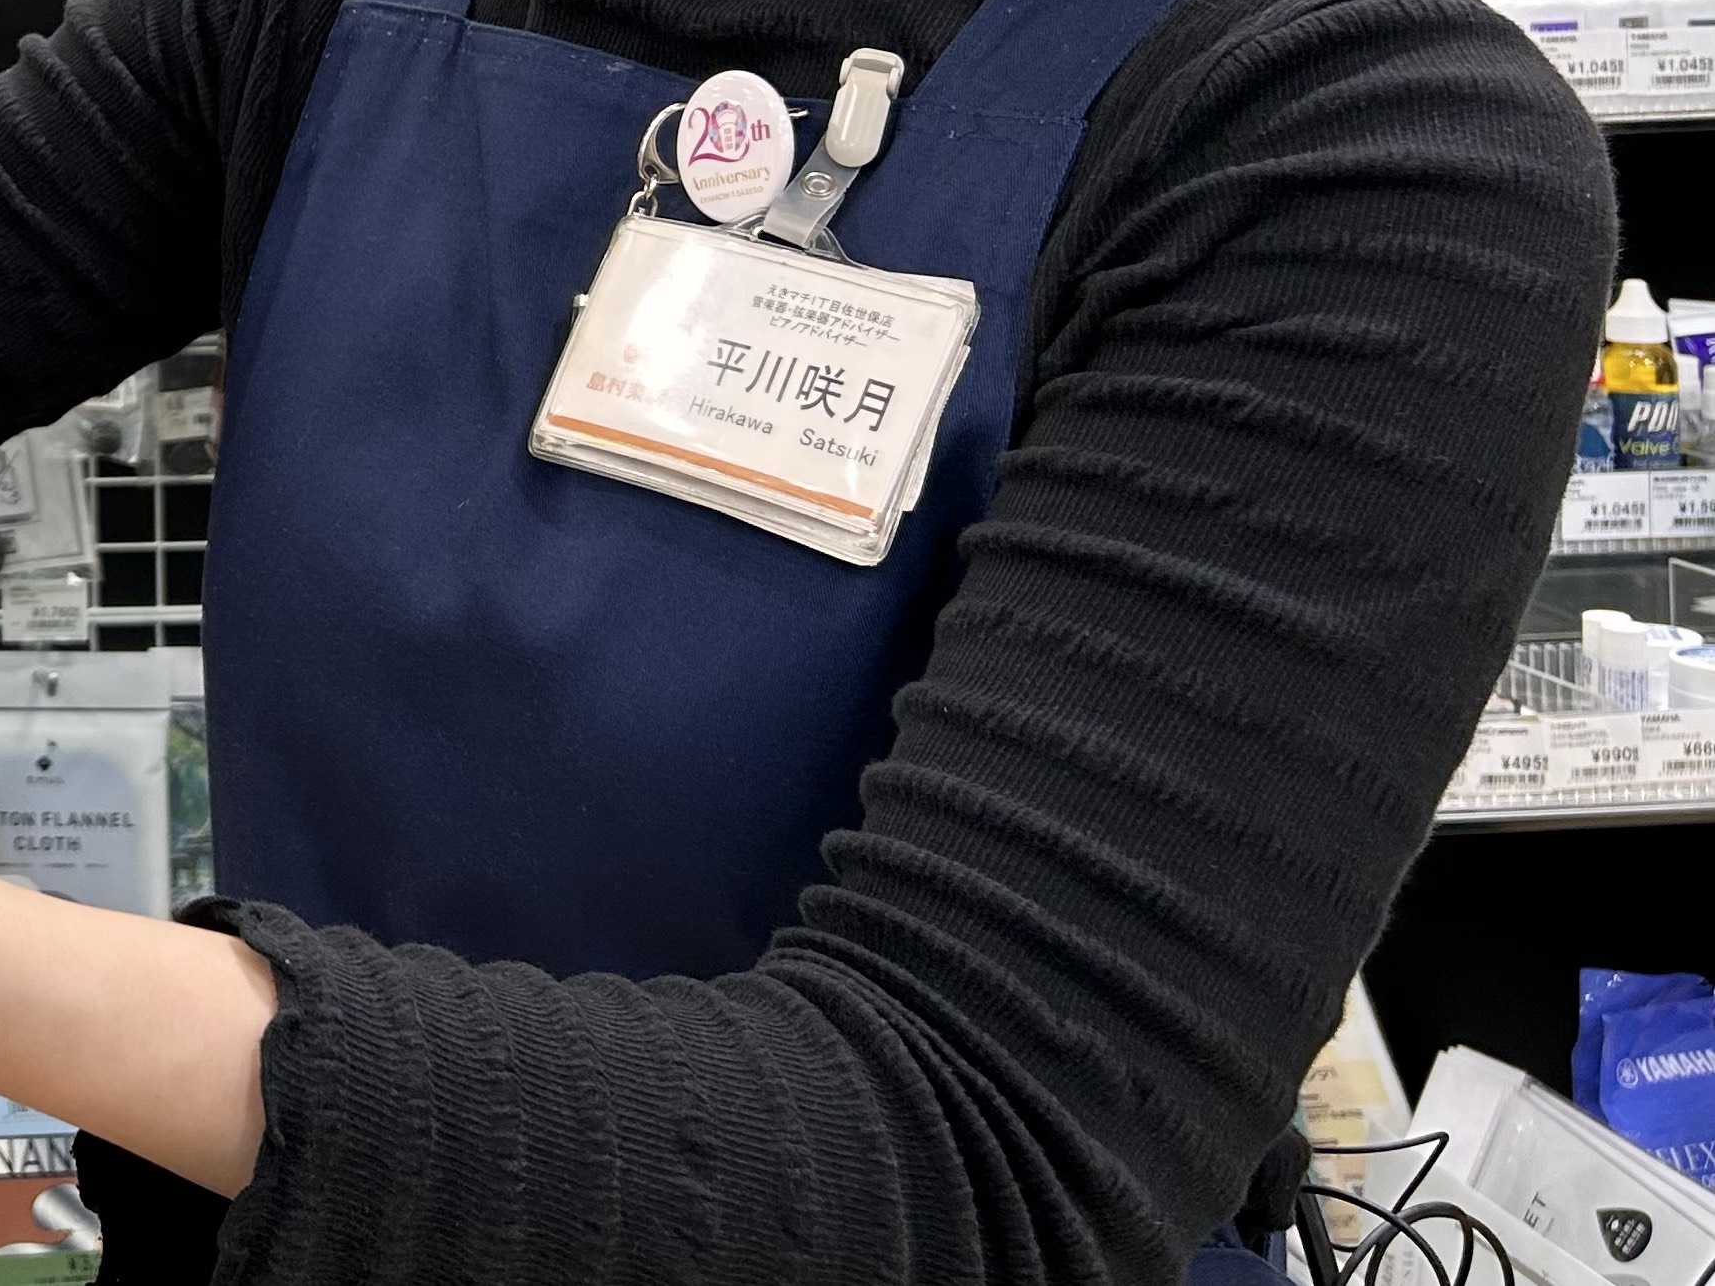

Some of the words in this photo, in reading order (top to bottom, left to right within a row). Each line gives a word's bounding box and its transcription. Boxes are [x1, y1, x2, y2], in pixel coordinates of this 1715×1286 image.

[691, 164, 773, 192] Anniversary
[752, 294, 902, 342] 管楽器・弦楽器アドバイザー
[766, 283, 896, 329] えきマチ1丁目佐世保店
[769, 315, 868, 348] ピアノアドバイザー
[706, 337, 897, 433] 平川咲月
[688, 395, 774, 435] Hirakawa
[799, 427, 879, 467] Satsuki
[1618, 437, 1670, 456] Valve
[40, 811, 136, 828] FLANNEL
[12, 835, 82, 852] CLOTH
